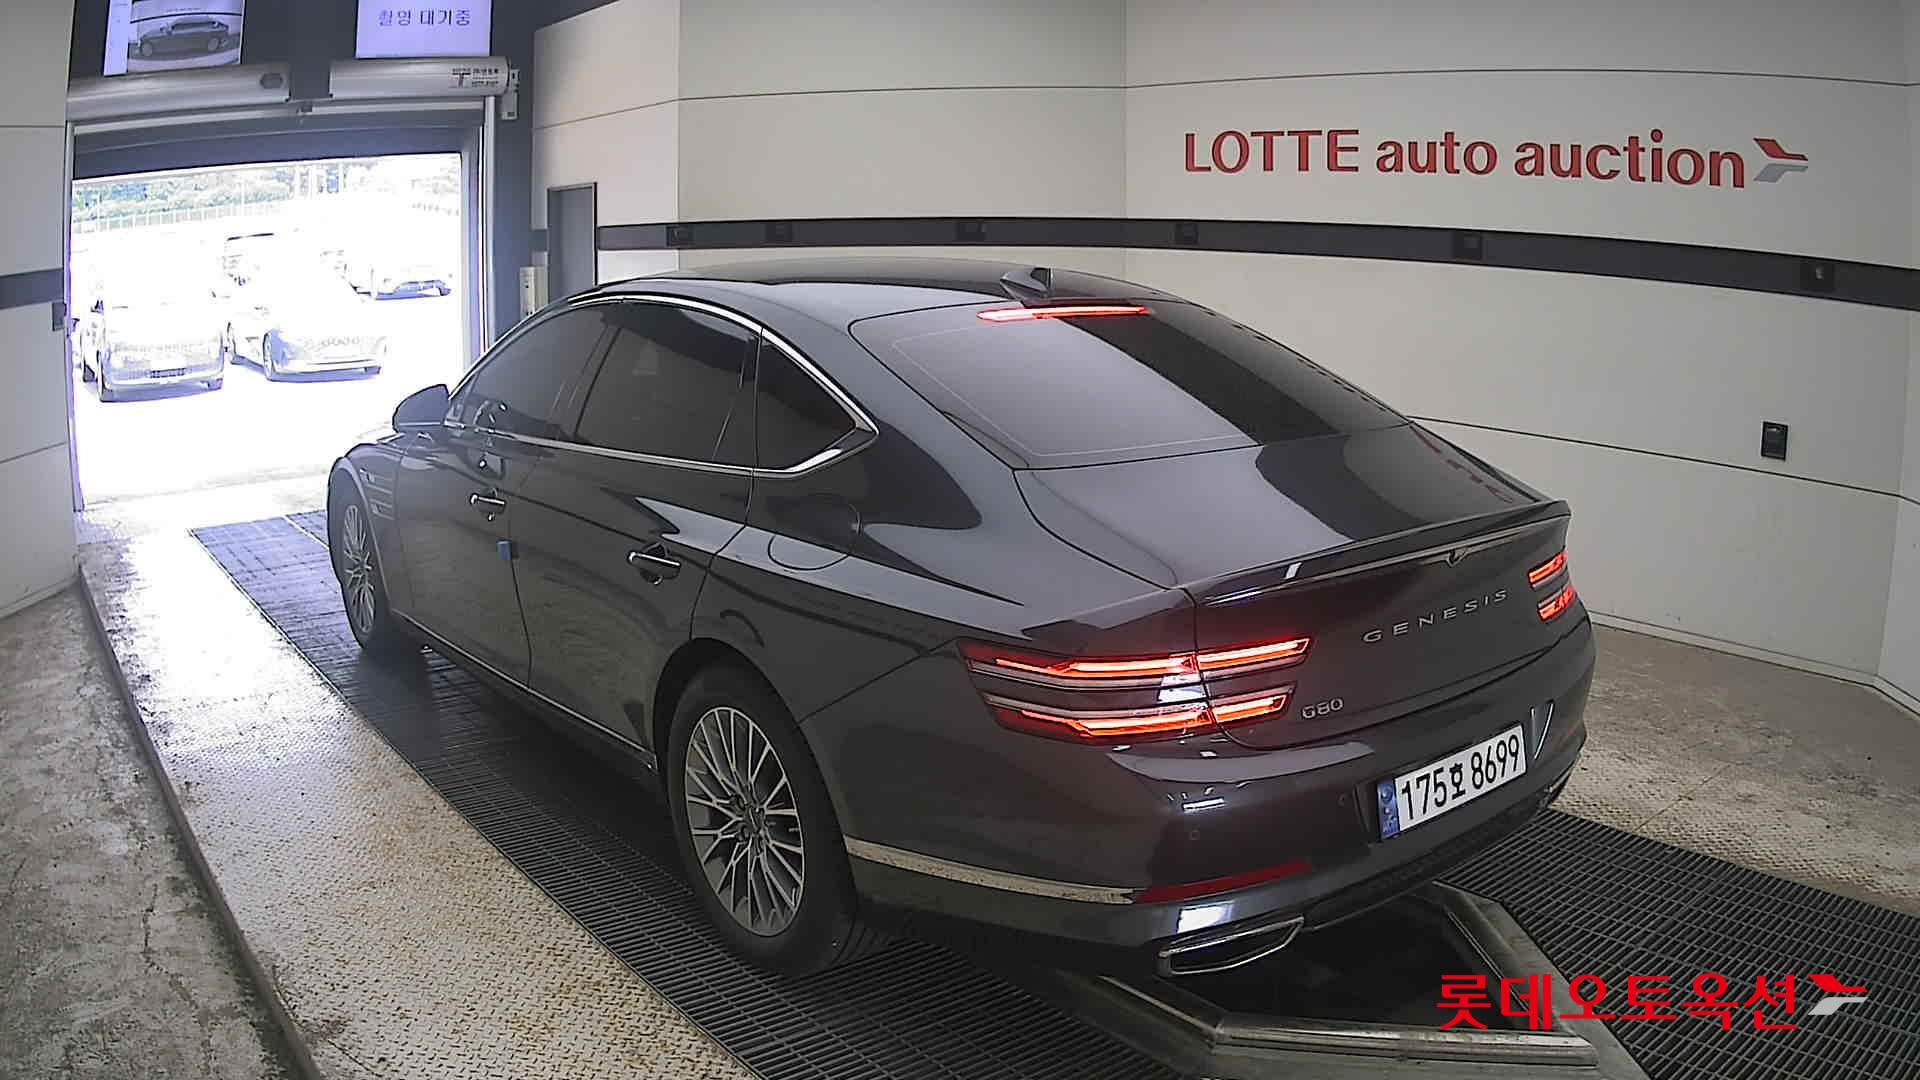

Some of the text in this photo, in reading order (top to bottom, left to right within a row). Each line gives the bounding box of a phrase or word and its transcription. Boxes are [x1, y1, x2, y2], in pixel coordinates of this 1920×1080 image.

[419, 9, 471, 27] 대기중
[1184, 128, 1746, 189] LOTTE auto auction
[1362, 589, 1508, 644] GENESIS
[1301, 697, 1345, 720] G80
[1401, 734, 1520, 820] 175호 8699
